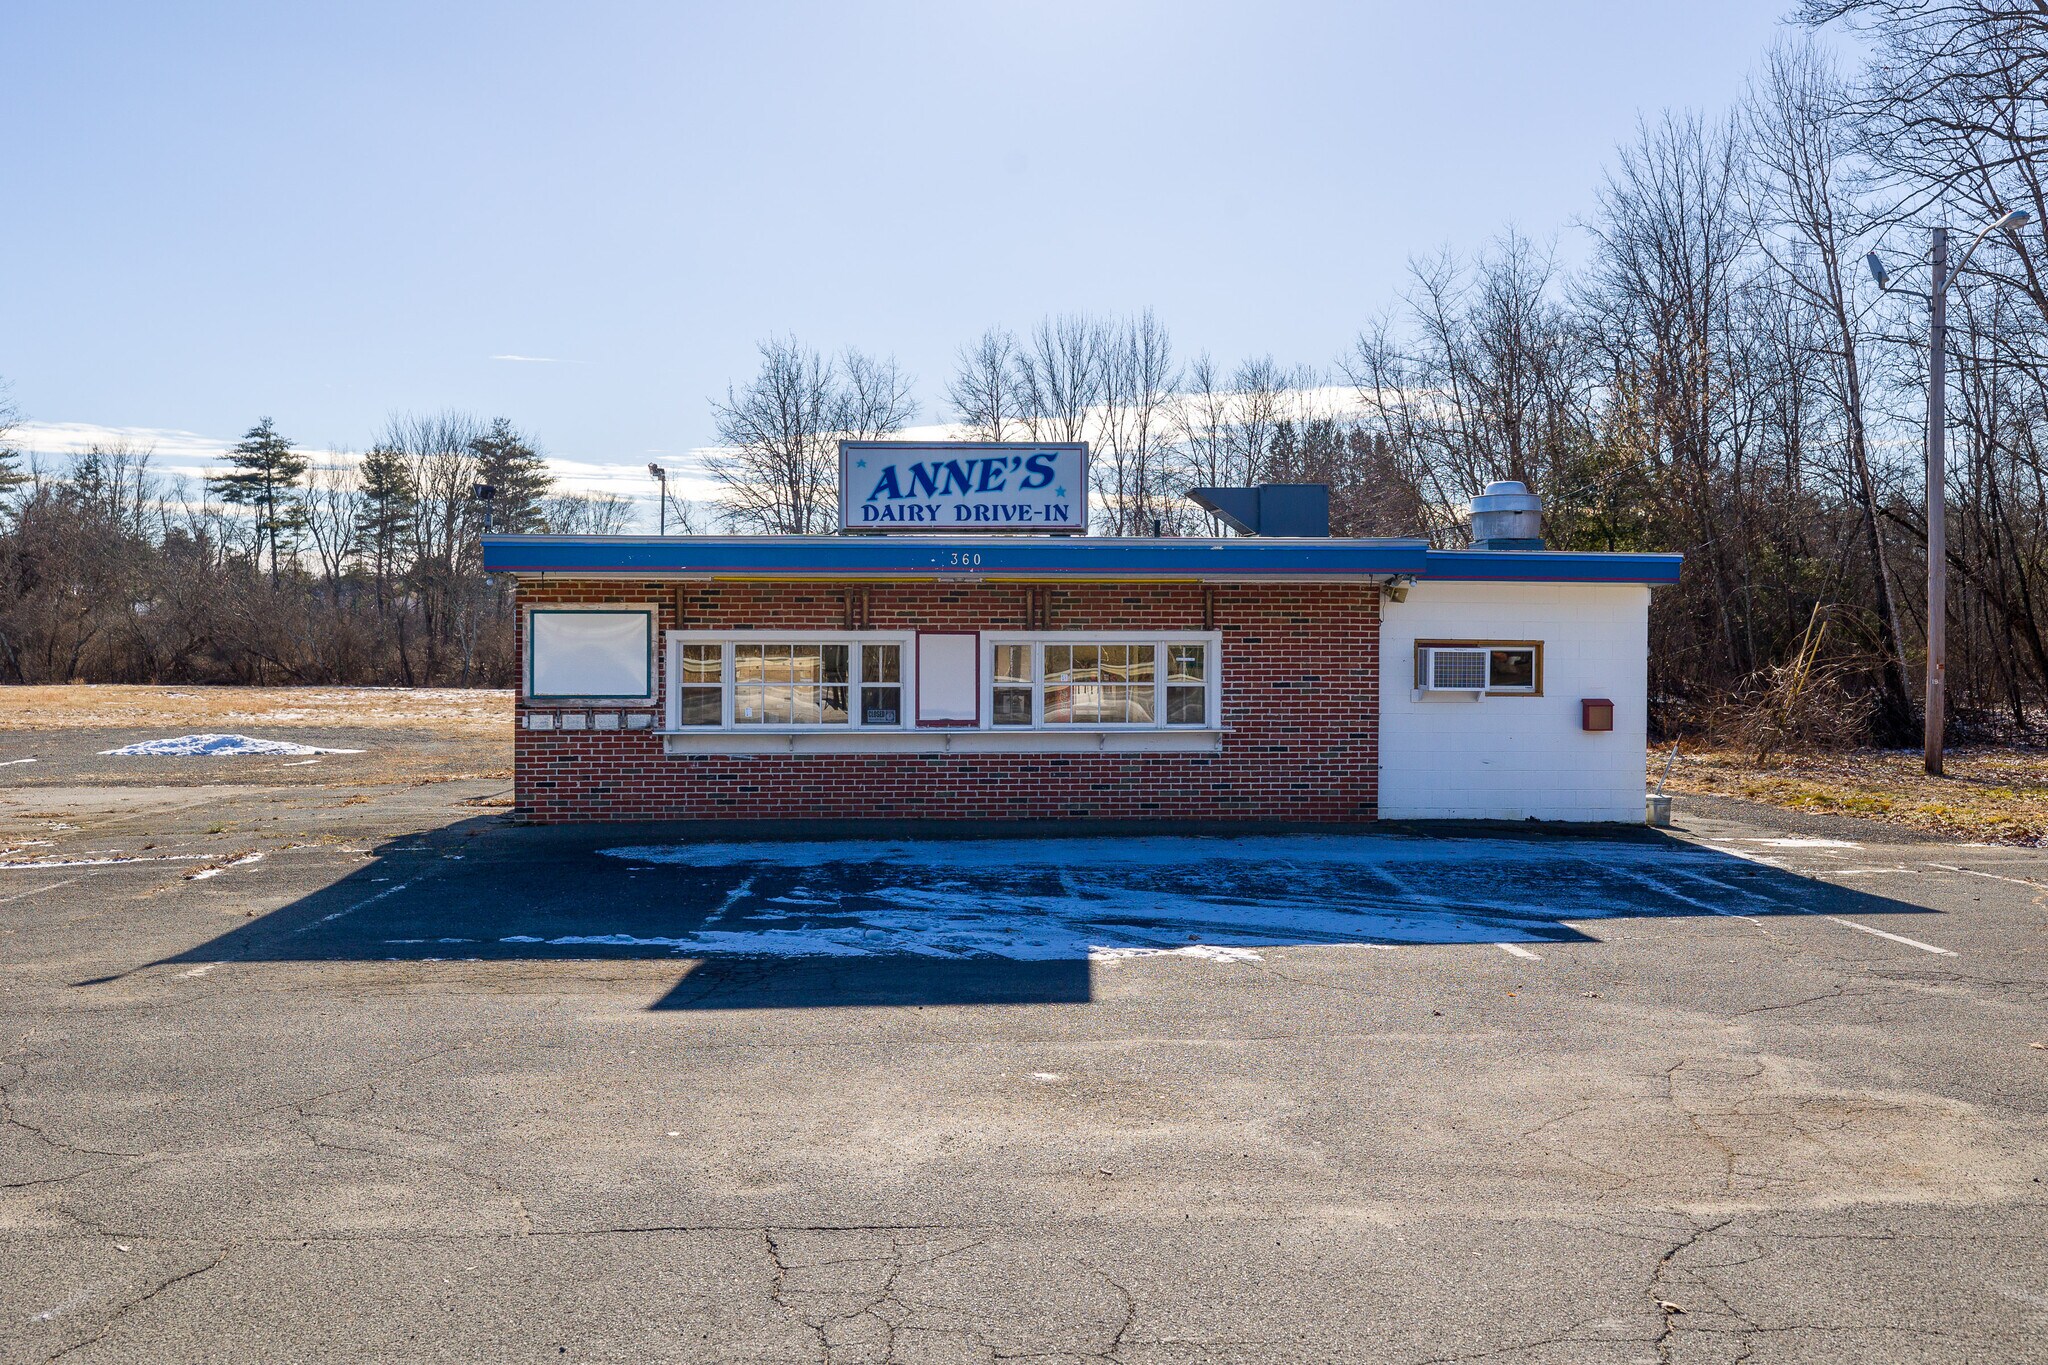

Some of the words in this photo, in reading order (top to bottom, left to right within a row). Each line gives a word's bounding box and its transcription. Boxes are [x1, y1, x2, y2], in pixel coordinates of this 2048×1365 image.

[866, 451, 1059, 501] ANNE'S
[861, 504, 941, 522] DAIRY
[953, 504, 1070, 522] DRIVE-IN
[950, 553, 981, 565] 360
